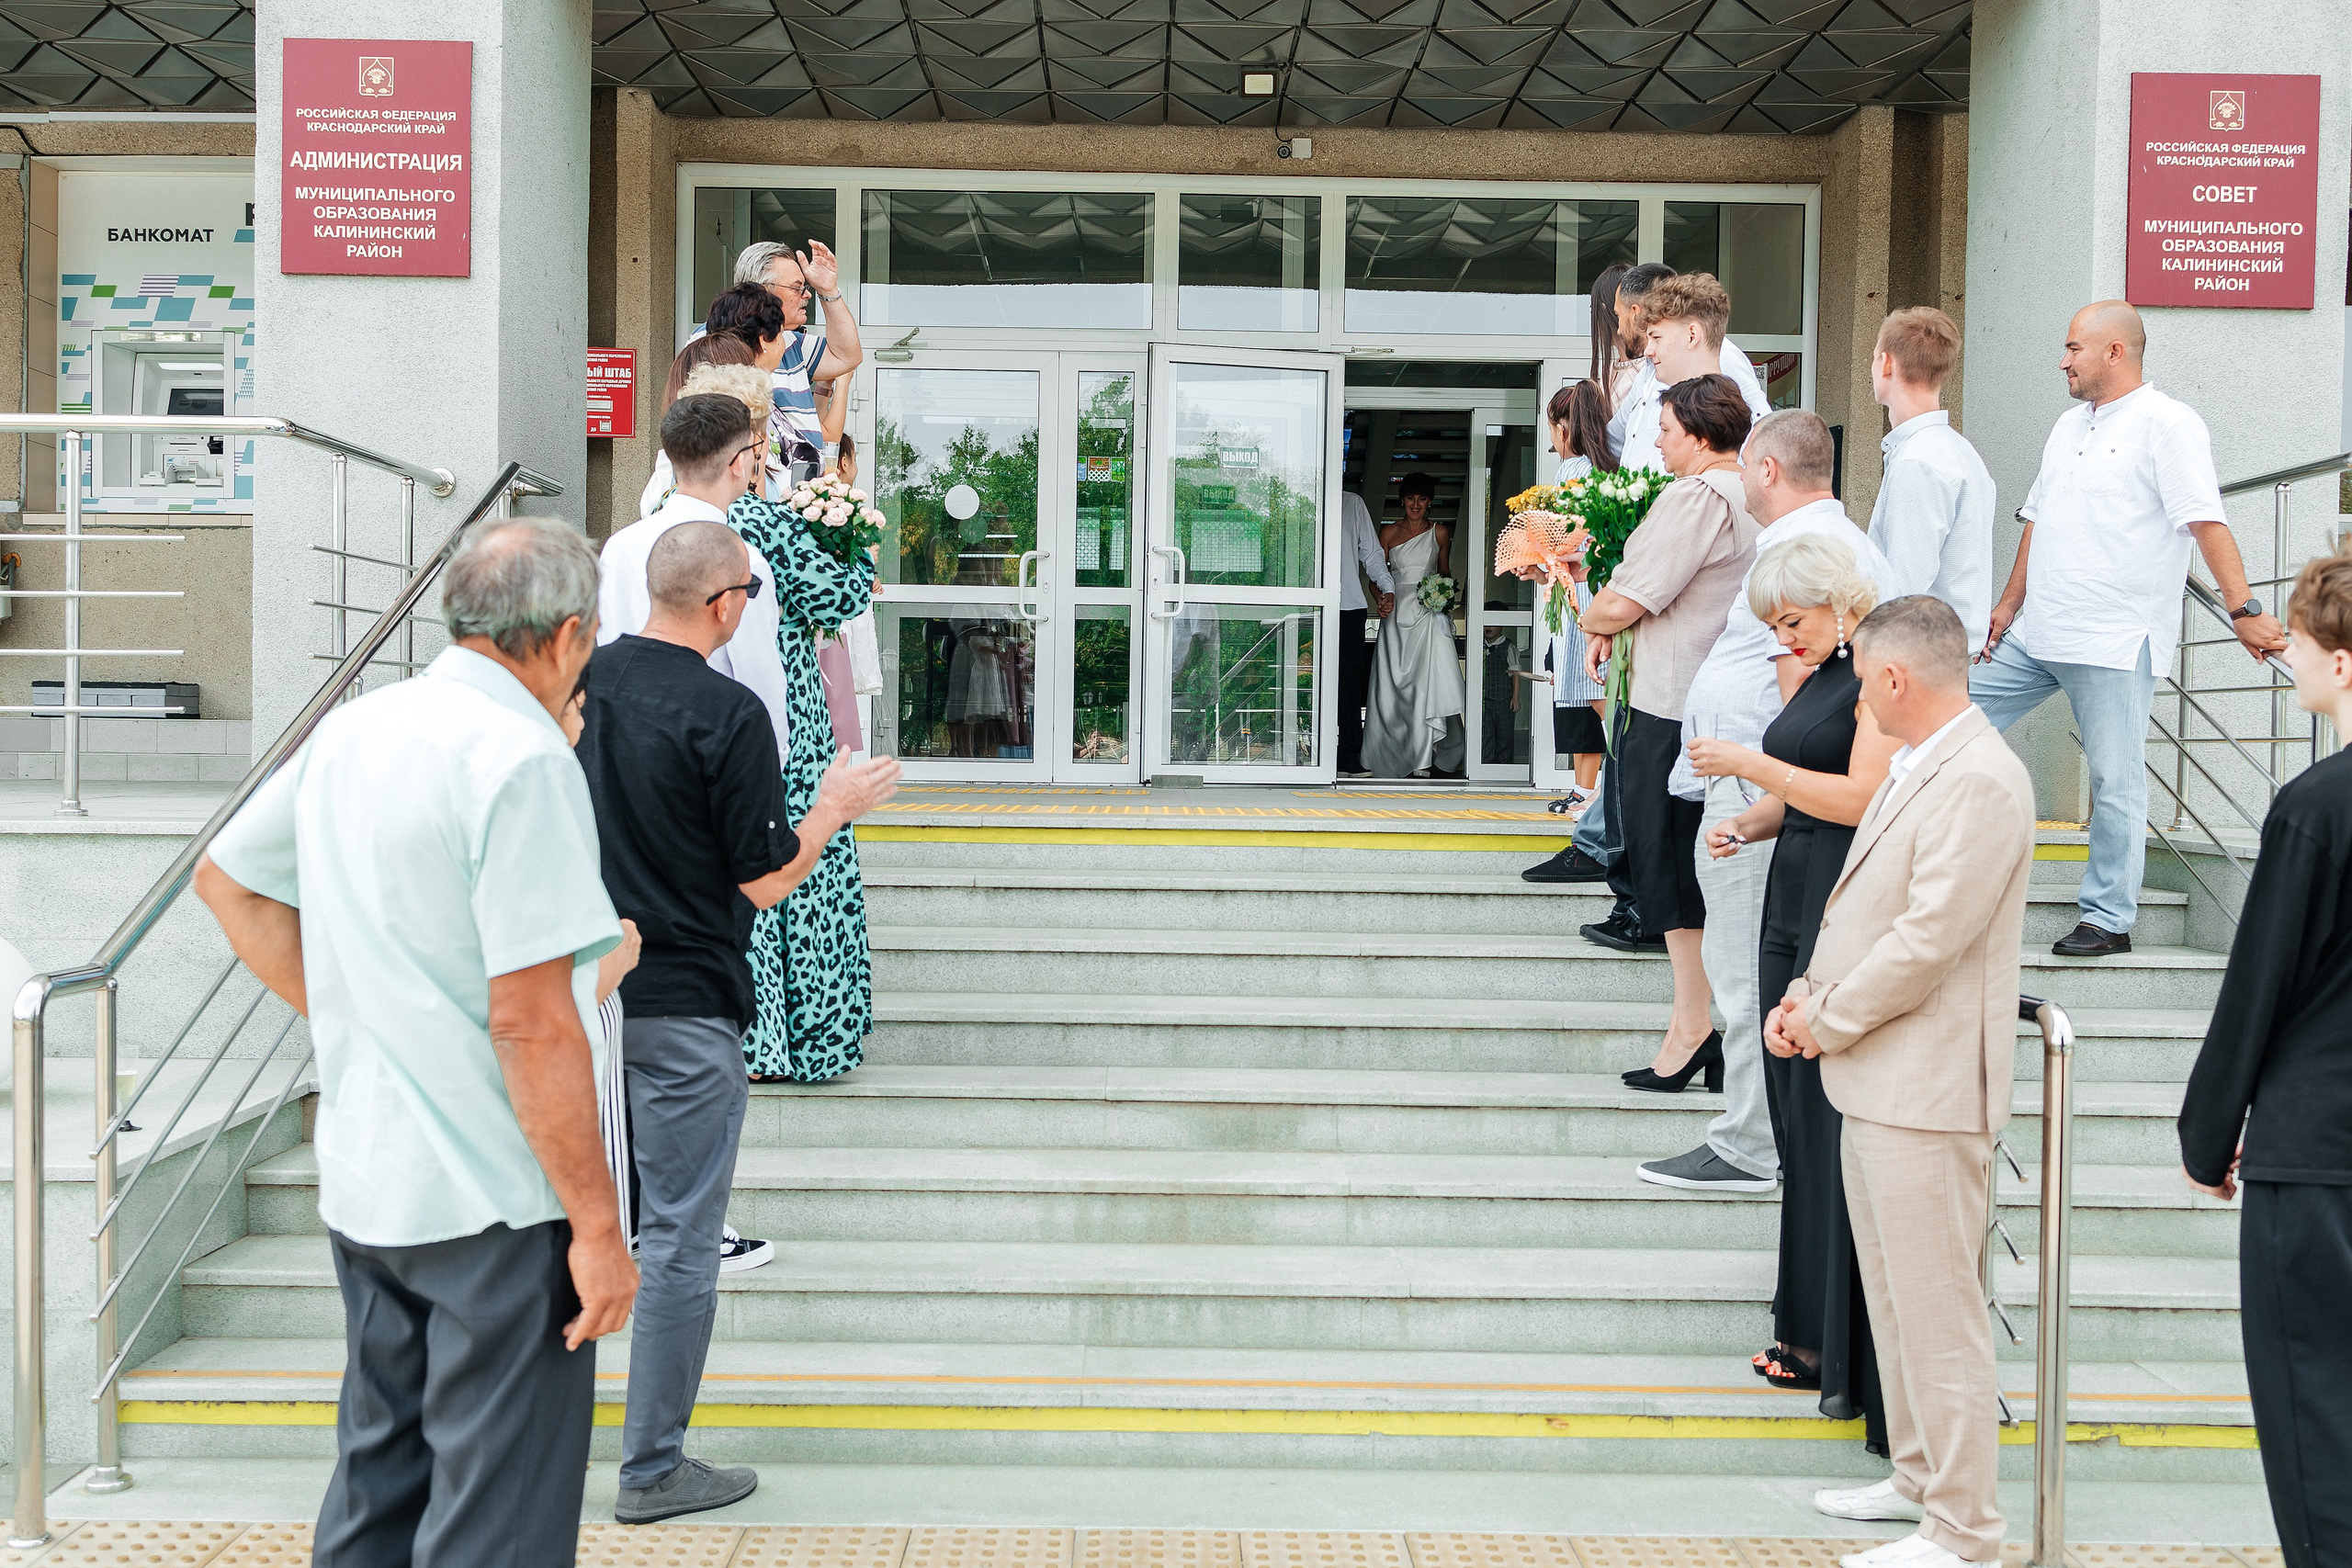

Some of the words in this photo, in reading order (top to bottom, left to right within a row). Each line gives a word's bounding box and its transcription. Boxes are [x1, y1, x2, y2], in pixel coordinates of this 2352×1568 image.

[296, 107, 379, 119] РОССИЙСКАЯ
[381, 109, 457, 122] ФЕДЕРАЦИЯ
[307, 121, 412, 134] КРАСНОДАРСКИЙ
[414, 122, 446, 134] КРАЙ
[2145, 141, 2229, 153] РОССИЙСКАЯ
[2231, 143, 2306, 156] ФЕДЕРАЦИЯ
[289, 151, 462, 173] АДМИНИСТРАЦИЯ
[2156, 154, 2261, 167] КРАСНОДАРСКИЙ
[2263, 155, 2295, 168] КРАЙ
[295, 186, 456, 203] МУНИЦИПАЛЬНОГО
[2192, 186, 2257, 203] СОВЕТ
[313, 206, 436, 221] ОБРАЗОВАНИЯ
[107, 228, 214, 243] БАНКОМАТ
[313, 224, 436, 240] КАЛИНИНСКИЙ
[2144, 220, 2303, 236] МУНИЦИПАЛЬНОГО
[346, 242, 402, 258] РАЙОН
[2162, 239, 2284, 254] ОБРАЗОВАНИЯ
[2162, 257, 2283, 273] КАЛИНИНСКИЙ
[2194, 275, 2250, 291] РАЙОН
[587, 366, 603, 377] ЫЙ
[605, 367, 631, 378] ШТАБ
